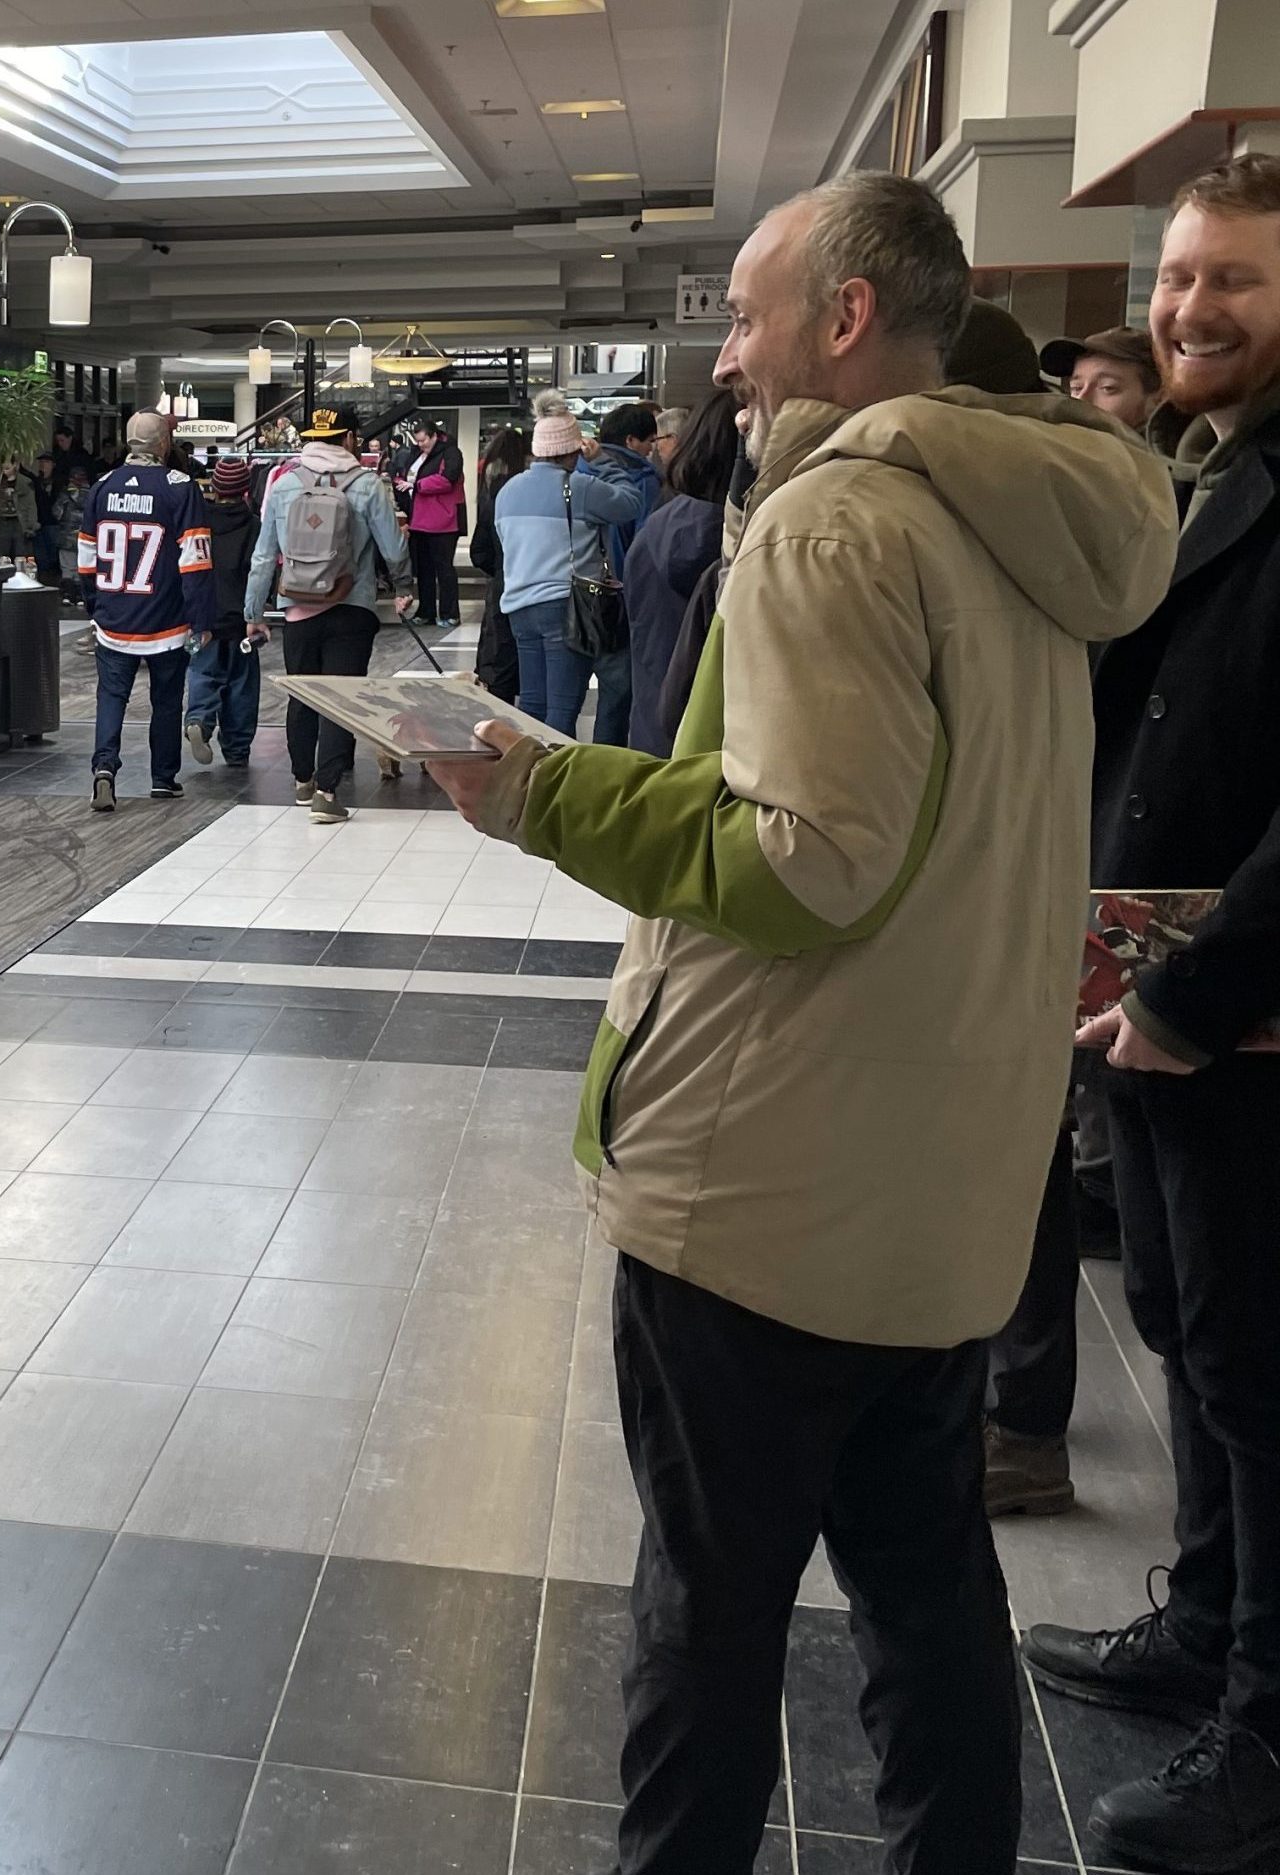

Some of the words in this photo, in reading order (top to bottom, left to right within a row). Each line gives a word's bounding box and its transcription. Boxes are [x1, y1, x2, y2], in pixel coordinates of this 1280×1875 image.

[176, 424, 230, 433] DIRECTORY
[107, 492, 153, 515] McDAVID
[96, 520, 165, 594] 97
